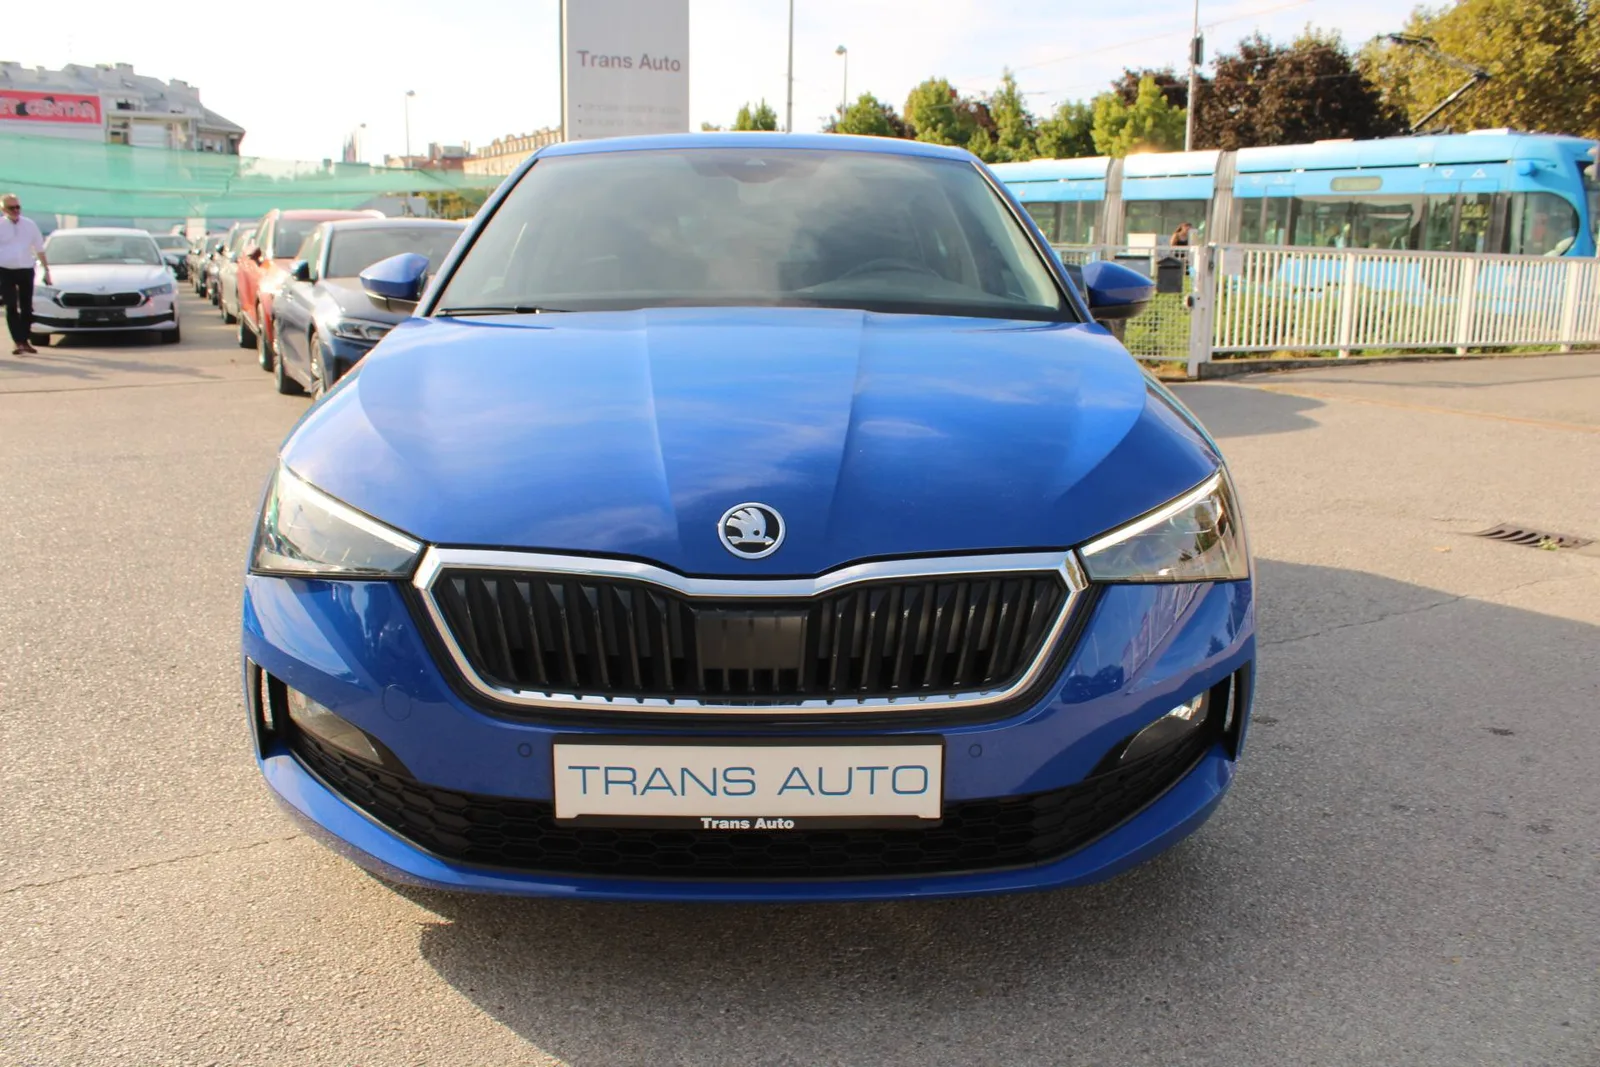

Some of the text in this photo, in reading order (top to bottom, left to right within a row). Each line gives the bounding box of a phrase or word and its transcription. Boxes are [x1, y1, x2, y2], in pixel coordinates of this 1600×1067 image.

[576, 50, 681, 72] Trans Auto
[568, 764, 929, 796] TRANS AUTO
[700, 817, 795, 829] Trans Auto
